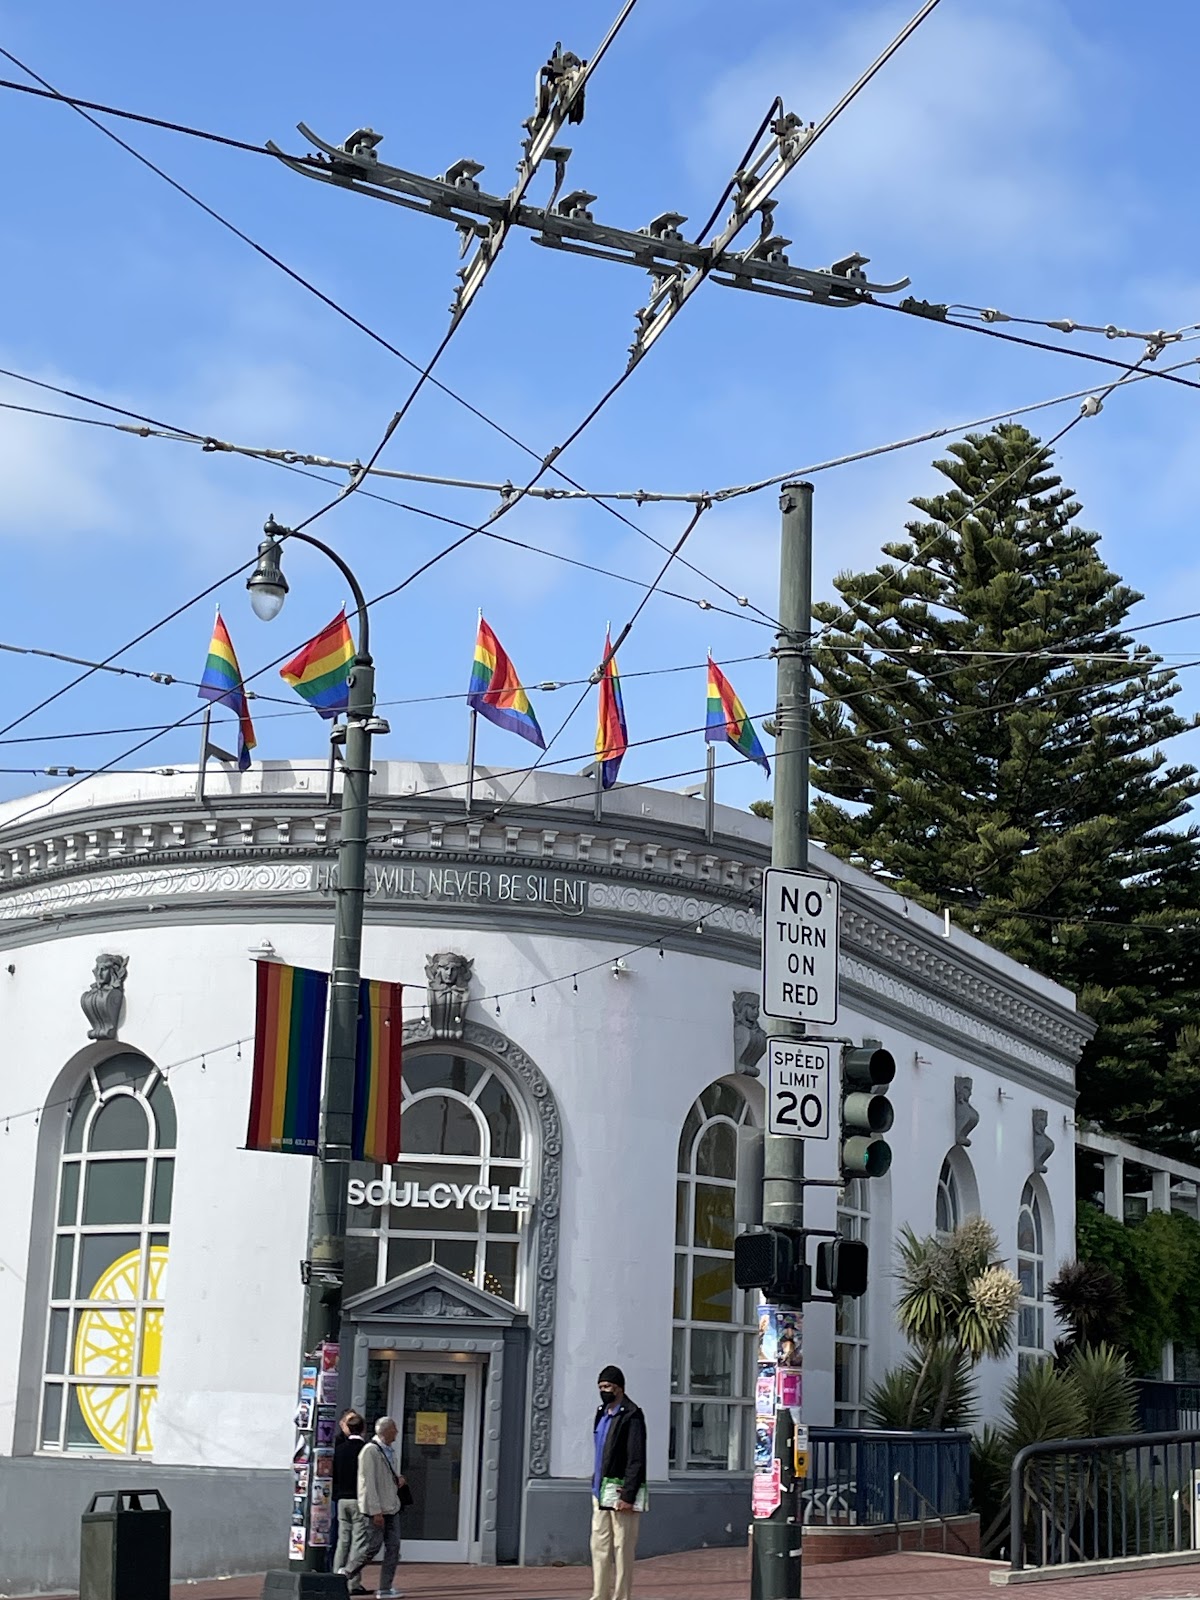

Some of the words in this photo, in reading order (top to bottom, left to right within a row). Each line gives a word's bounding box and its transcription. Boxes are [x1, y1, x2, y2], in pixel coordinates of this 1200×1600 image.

[373, 866, 421, 894] WILL
[428, 868, 491, 897] NEVER
[499, 873, 522, 901] BE
[526, 874, 587, 905] SILENT
[781, 886, 823, 917] NO
[776, 921, 827, 948] TURN
[787, 953, 815, 976] ON
[782, 982, 819, 1006] RED
[774, 1051, 825, 1070] SPEED
[779, 1071, 819, 1089] LIMIT
[775, 1091, 823, 1128] 20
[347, 1178, 531, 1212] SOULCYCLE
